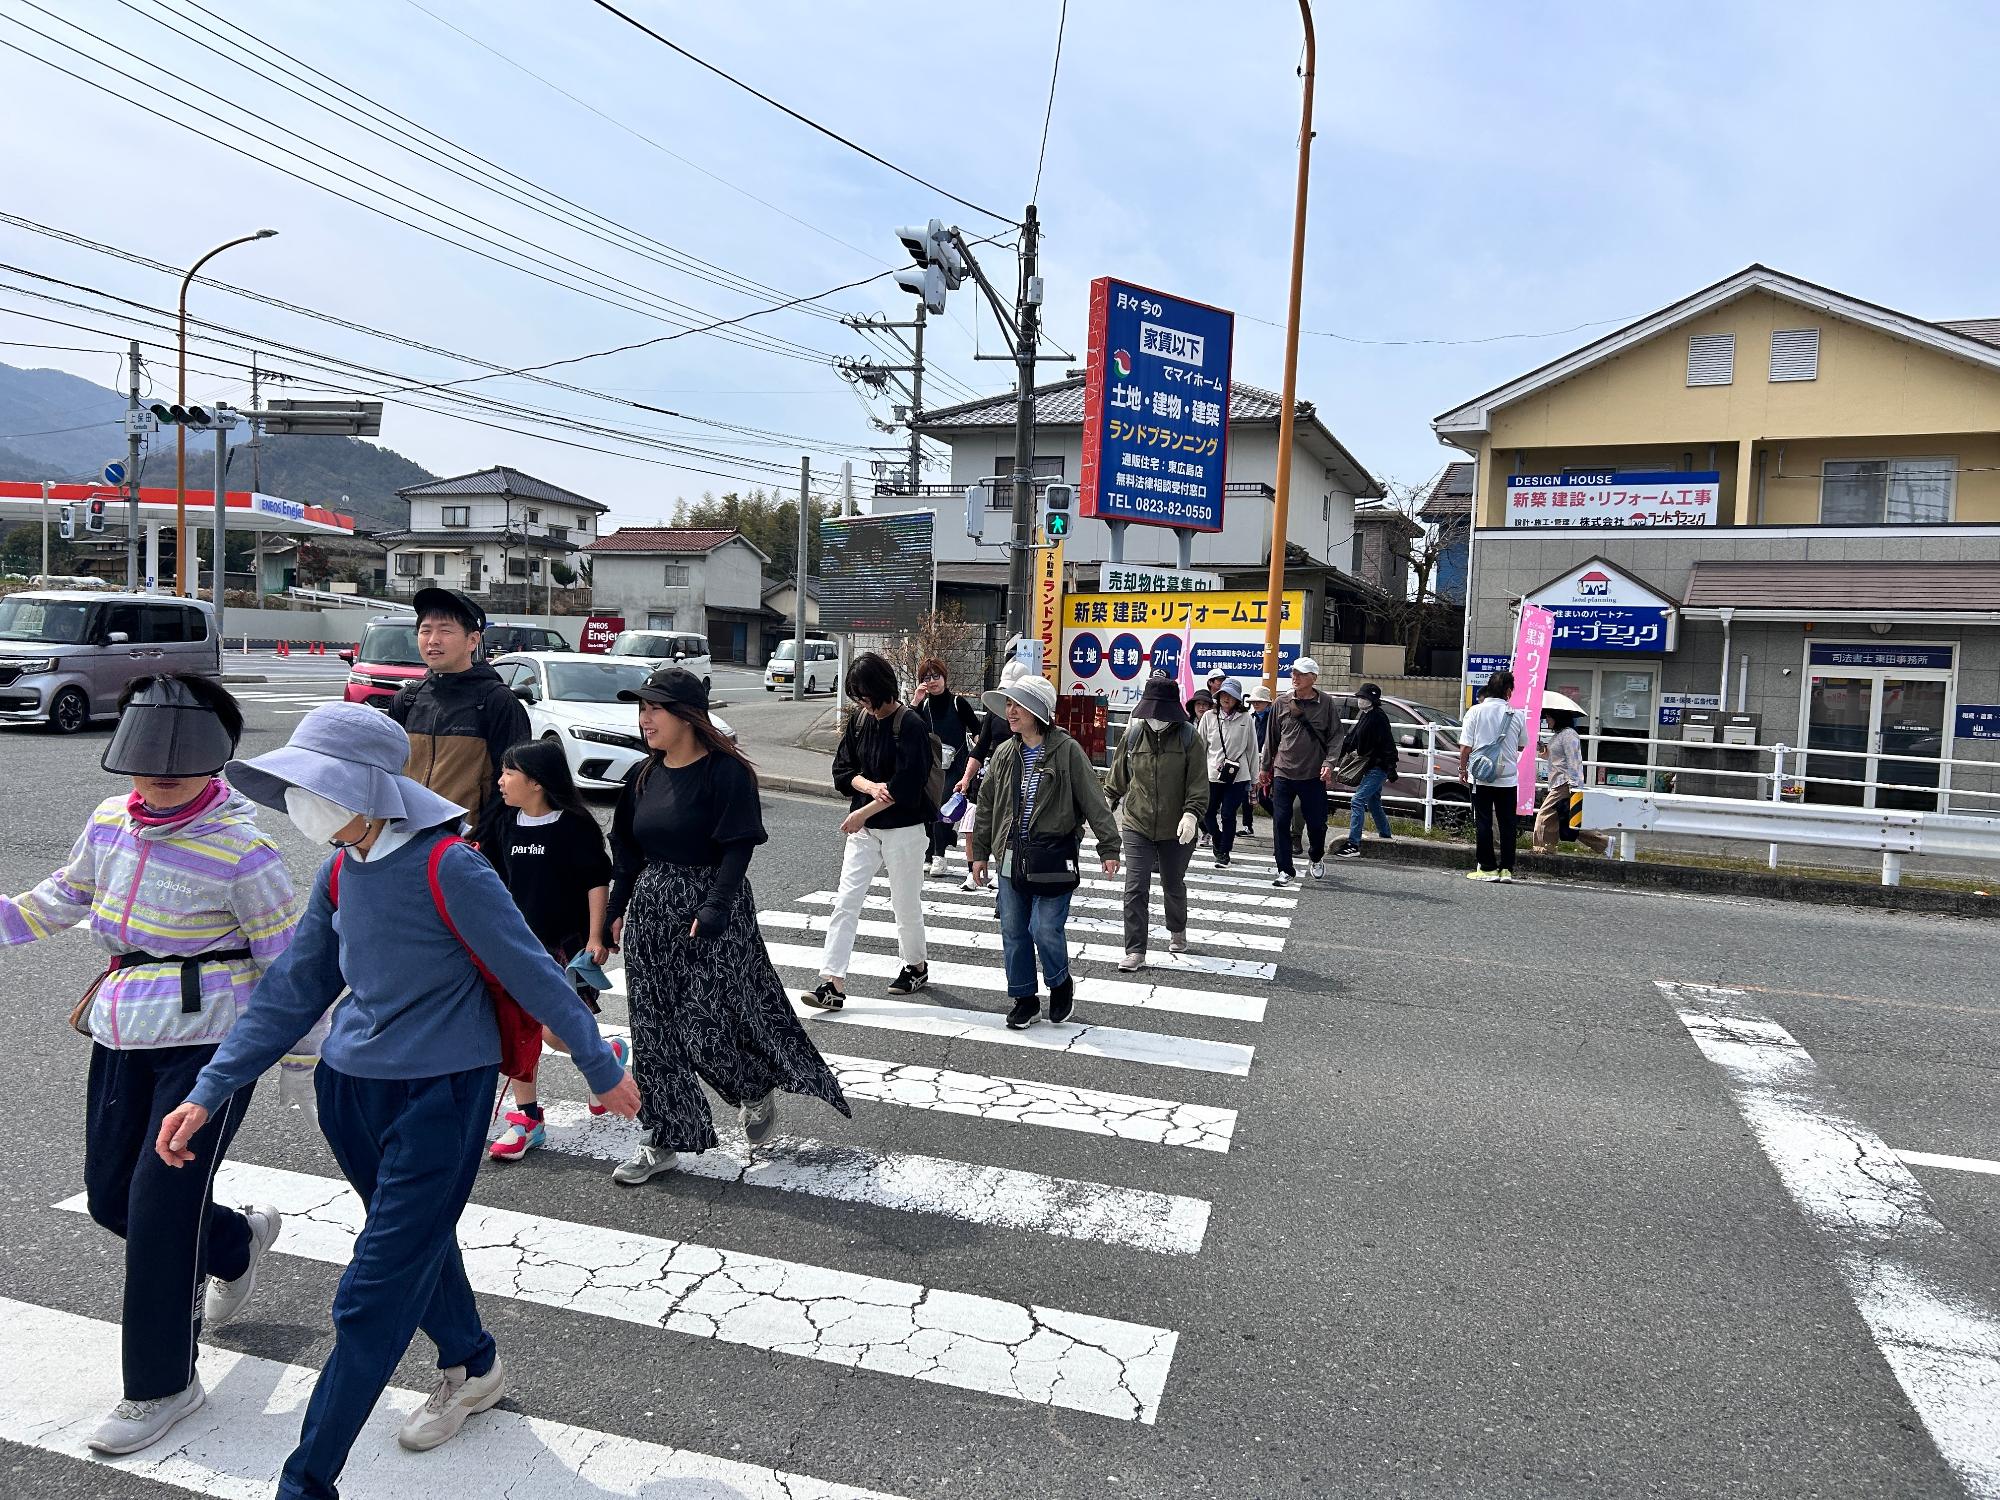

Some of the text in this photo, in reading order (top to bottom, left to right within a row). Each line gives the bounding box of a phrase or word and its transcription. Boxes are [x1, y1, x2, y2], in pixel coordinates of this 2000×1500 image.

[1117, 293, 1162, 318] 月々今の
[1144, 328, 1200, 360] 家賃以下
[1163, 366, 1222, 391] でマイホーム
[1111, 383, 1220, 427] 土地・建物・建築
[1110, 419, 1218, 456] ランドプランニング
[1116, 472, 1207, 498] 無料法律相談受付窓口
[1516, 475, 1612, 486] DESIGN HOUSE
[262, 499, 281, 514] ENEOS
[1107, 493, 1212, 520] TEL 0823-82-0550
[1513, 489, 1711, 508] 新築 建設・リフォーム工事
[1579, 516, 1624, 527] 株式会社
[1075, 602, 1108, 623] 新築
[588, 630, 618, 643] EneJet
[1073, 647, 1097, 663] 土地
[1113, 648, 1139, 666] 建物
[156, 880, 191, 895] adidas
